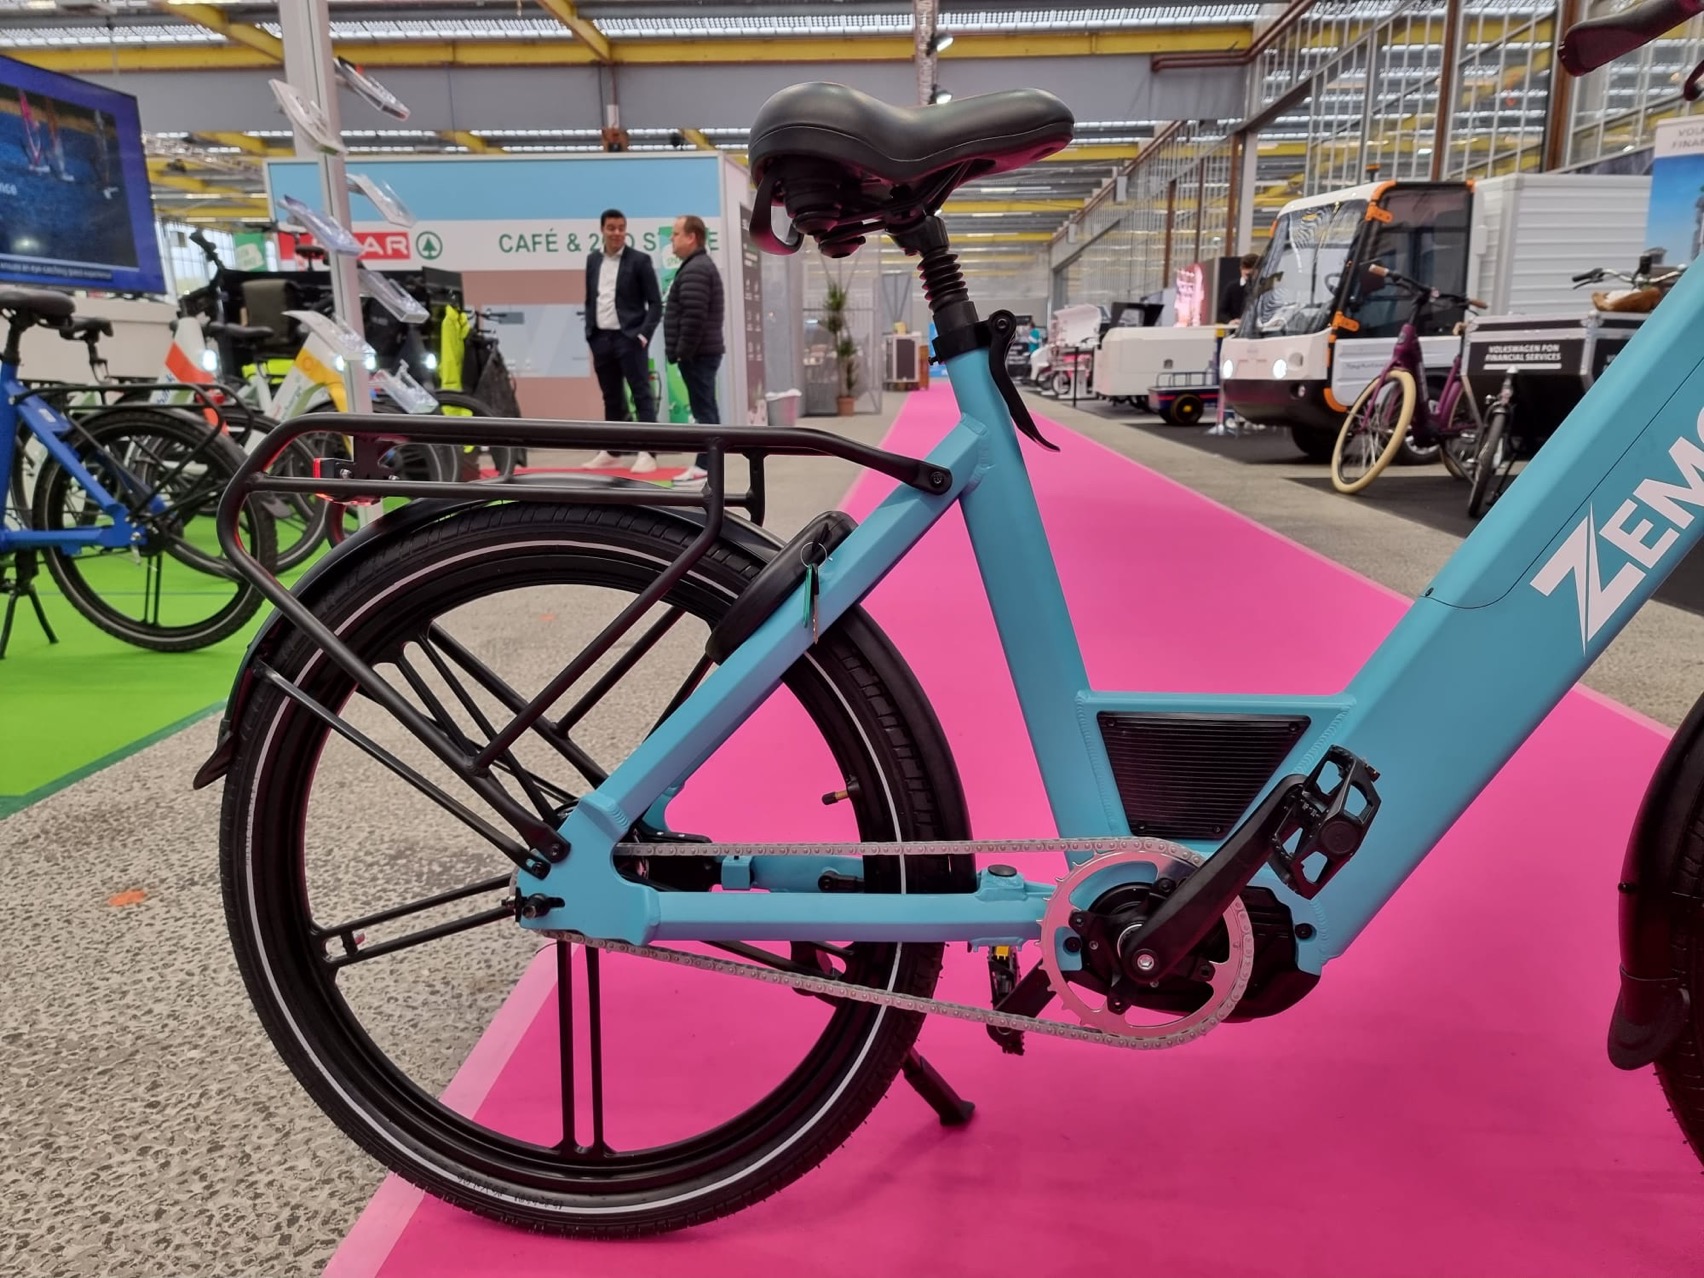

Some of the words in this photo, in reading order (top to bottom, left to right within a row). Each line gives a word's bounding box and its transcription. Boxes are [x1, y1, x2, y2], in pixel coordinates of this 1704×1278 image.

[499, 229, 558, 252] CAFÉ
[567, 234, 581, 252] &
[1485, 353, 1524, 361] FINANCIAL
[1525, 352, 1561, 361] SERVICES
[1489, 345, 1541, 353] VOLKSWAGEN
[1529, 407, 1704, 656] ZEM
